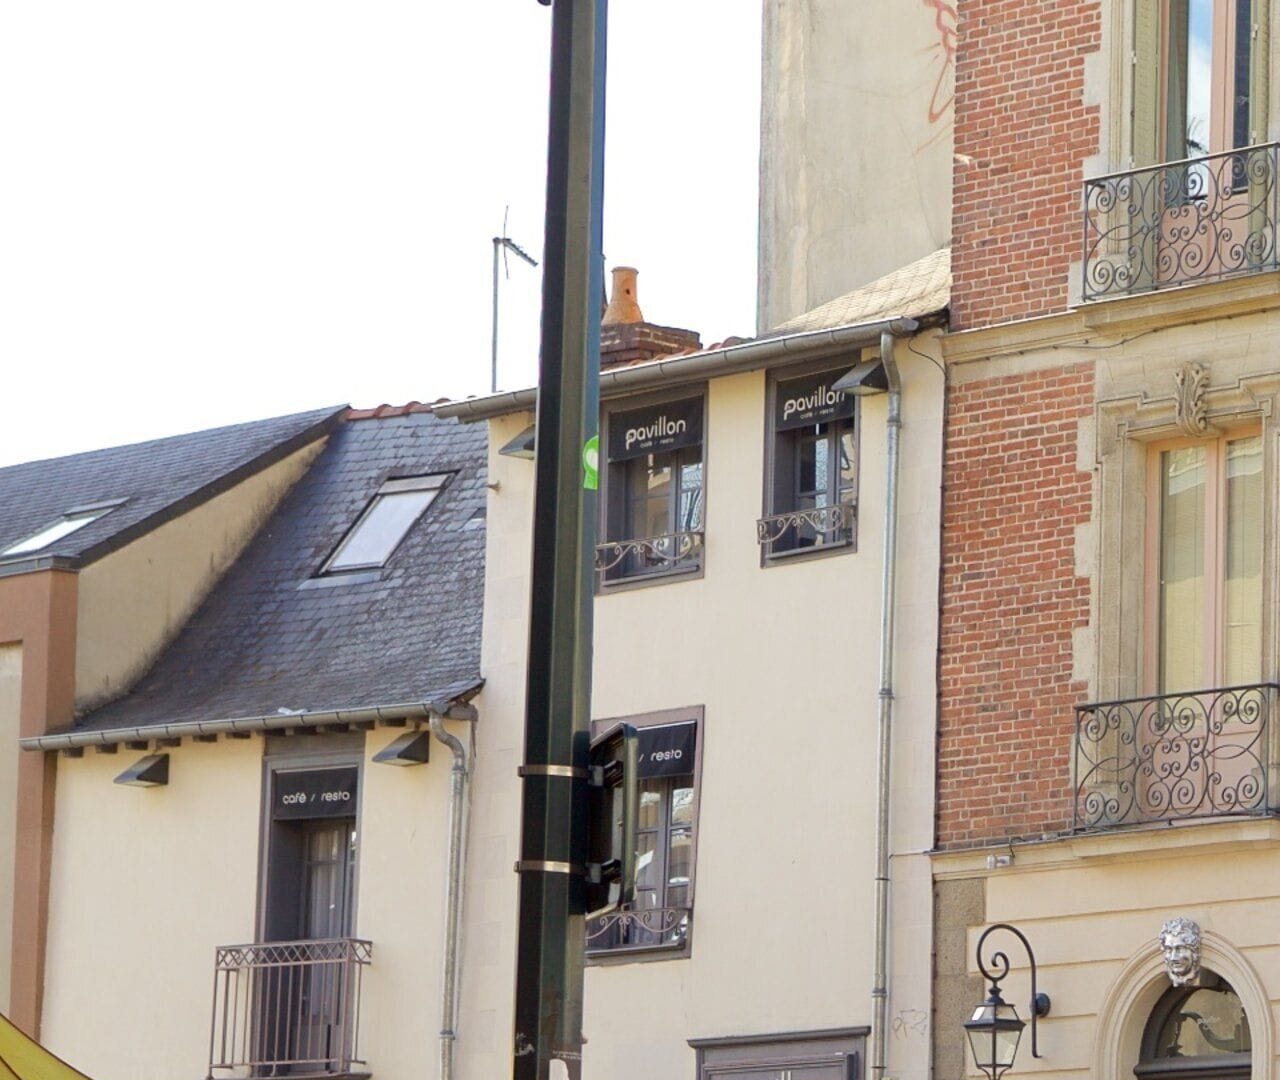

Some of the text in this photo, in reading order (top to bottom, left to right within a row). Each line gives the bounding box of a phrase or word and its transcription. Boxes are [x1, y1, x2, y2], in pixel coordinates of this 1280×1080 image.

[783, 385, 845, 421] pavillon
[625, 415, 686, 450] pavillon
[650, 749, 683, 762] resto
[320, 790, 351, 802] resto
